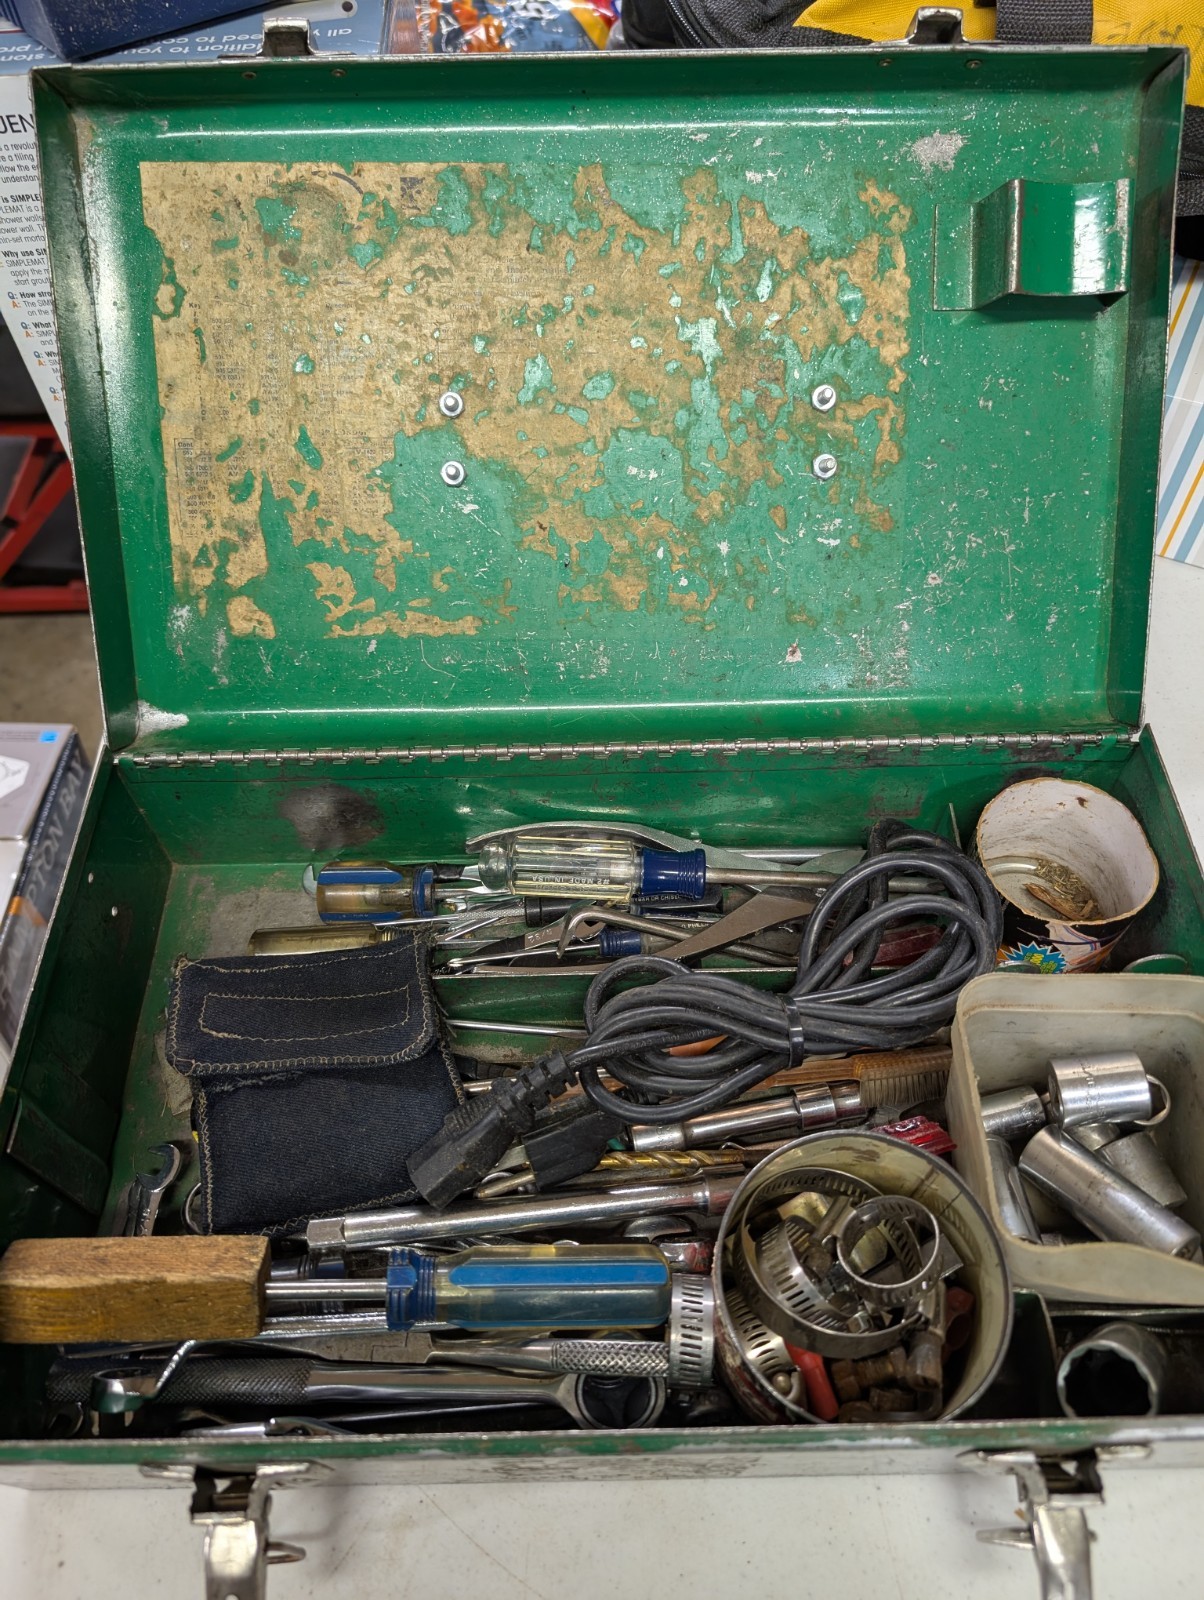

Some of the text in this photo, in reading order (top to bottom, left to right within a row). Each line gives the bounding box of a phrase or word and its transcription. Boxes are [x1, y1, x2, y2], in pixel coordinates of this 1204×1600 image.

[327, 27, 353, 37] all
[195, 34, 215, 43] to
[222, 33, 262, 42] eed
[170, 45, 189, 54] to
[14, 153, 35, 162] tiling
[10, 193, 42, 203] SIMPLE
[1, 250, 19, 258] Why
[6, 258, 45, 267] SIMPLEMAT
[11, 269, 29, 279] apply
[30, 267, 42, 275] the
[14, 278, 30, 286] start
[19, 291, 36, 299] How
[32, 321, 51, 329] What
[60, 750, 84, 820] BAY
[531, 875, 550, 883] USA
[568, 877, 594, 885] MADE
